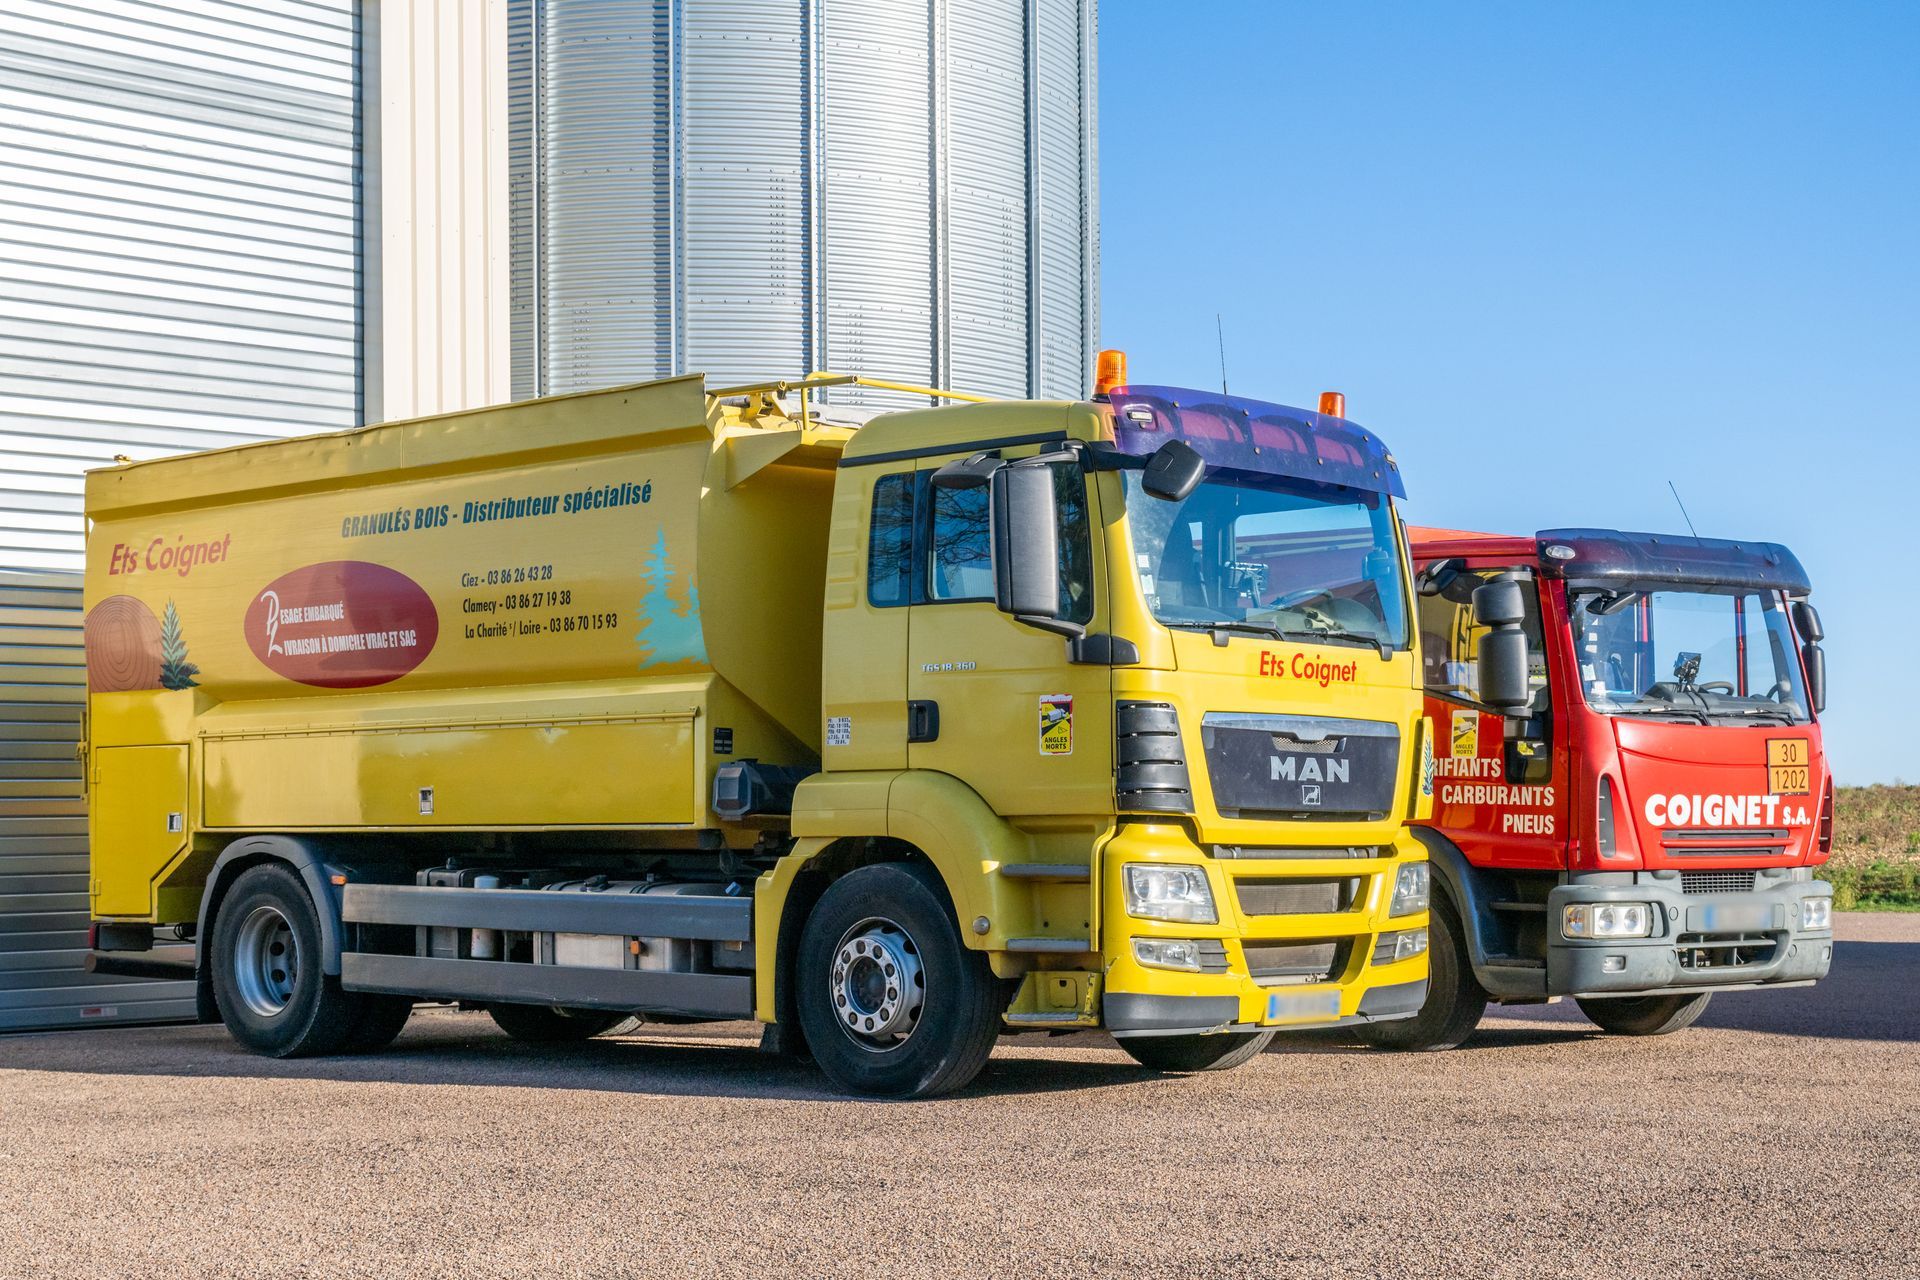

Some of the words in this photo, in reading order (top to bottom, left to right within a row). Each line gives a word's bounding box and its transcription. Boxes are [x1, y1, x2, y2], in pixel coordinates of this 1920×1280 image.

[341, 507, 411, 538] GRANULÉS
[414, 505, 449, 529] BOIS
[462, 494, 559, 524] Distributeur
[563, 479, 651, 514] spécialisé
[109, 543, 138, 576] Ets
[145, 533, 231, 577] Coignet
[461, 573, 479, 587] Ciez
[488, 570, 499, 585] 03
[501, 568, 512, 584] 86
[514, 567, 525, 583] 26
[527, 566, 539, 582] 43
[541, 564, 553, 580] 28
[303, 600, 345, 622] EMBARQUÉ
[463, 598, 497, 614] Clamecy
[505, 594, 517, 610] 03
[519, 593, 530, 609] 86
[532, 592, 544, 608] 27
[547, 591, 557, 607] 19
[560, 590, 571, 605] 38
[465, 624, 475, 639] La
[477, 621, 508, 638] Charité
[519, 620, 541, 635] Loire
[550, 617, 561, 633] 03
[564, 616, 575, 631] 86
[578, 615, 589, 631] 70
[592, 614, 603, 630] 15
[605, 612, 618, 629] 93
[327, 633, 366, 653] DOMICILE
[365, 631, 388, 650] VRAC
[388, 631, 398, 648] ET
[399, 629, 417, 647] SAC
[1259, 650, 1285, 677] Ets
[1291, 652, 1358, 688] Coignet
[1044, 736, 1068, 744] ANGLES
[1781, 743, 1797, 763] 30
[1270, 755, 1350, 784] MAN
[1775, 769, 1806, 790] 1202
[1441, 784, 1555, 807] CARBURANTS
[1644, 793, 1780, 827] COIGNET
[1782, 805, 1811, 826] S.A.
[1502, 813, 1555, 835] PNEUS
